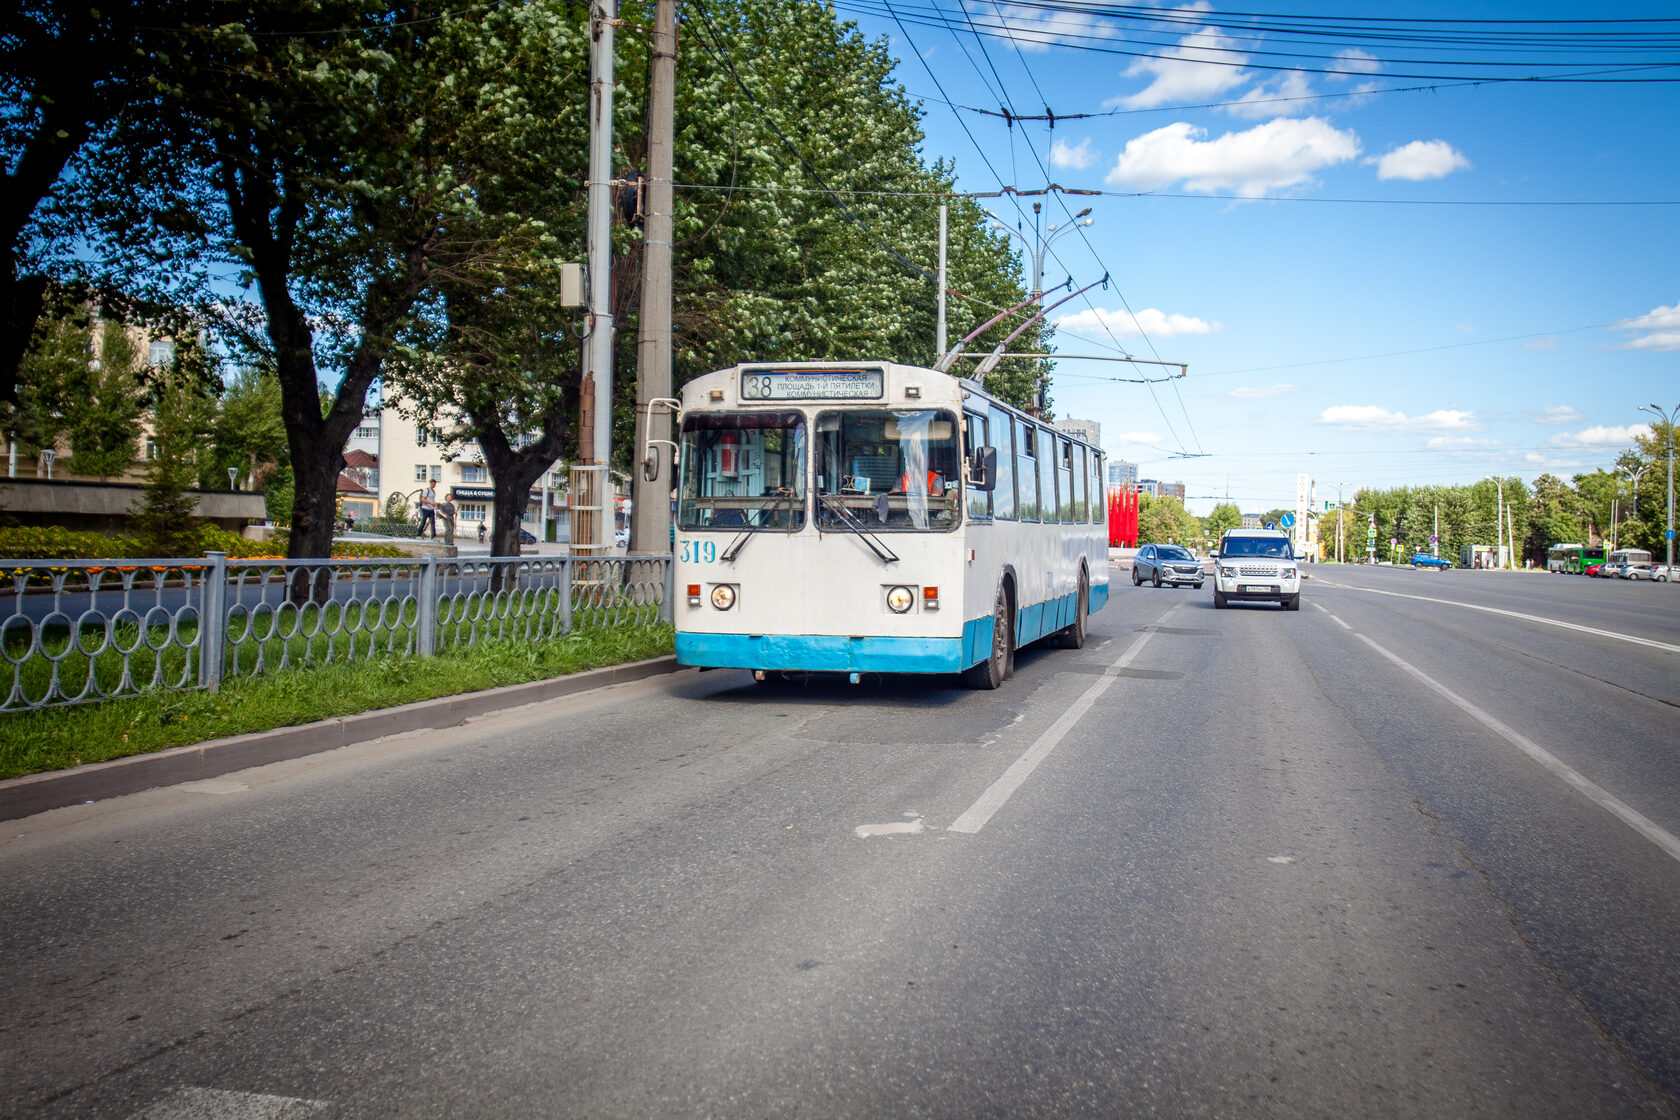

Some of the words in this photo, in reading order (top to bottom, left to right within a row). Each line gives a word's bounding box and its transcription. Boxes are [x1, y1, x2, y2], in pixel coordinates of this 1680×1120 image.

[748, 376, 772, 398] 38
[784, 374, 866, 382] КОММУНИСТИЧЕСКАЯ
[680, 540, 716, 563] 319
